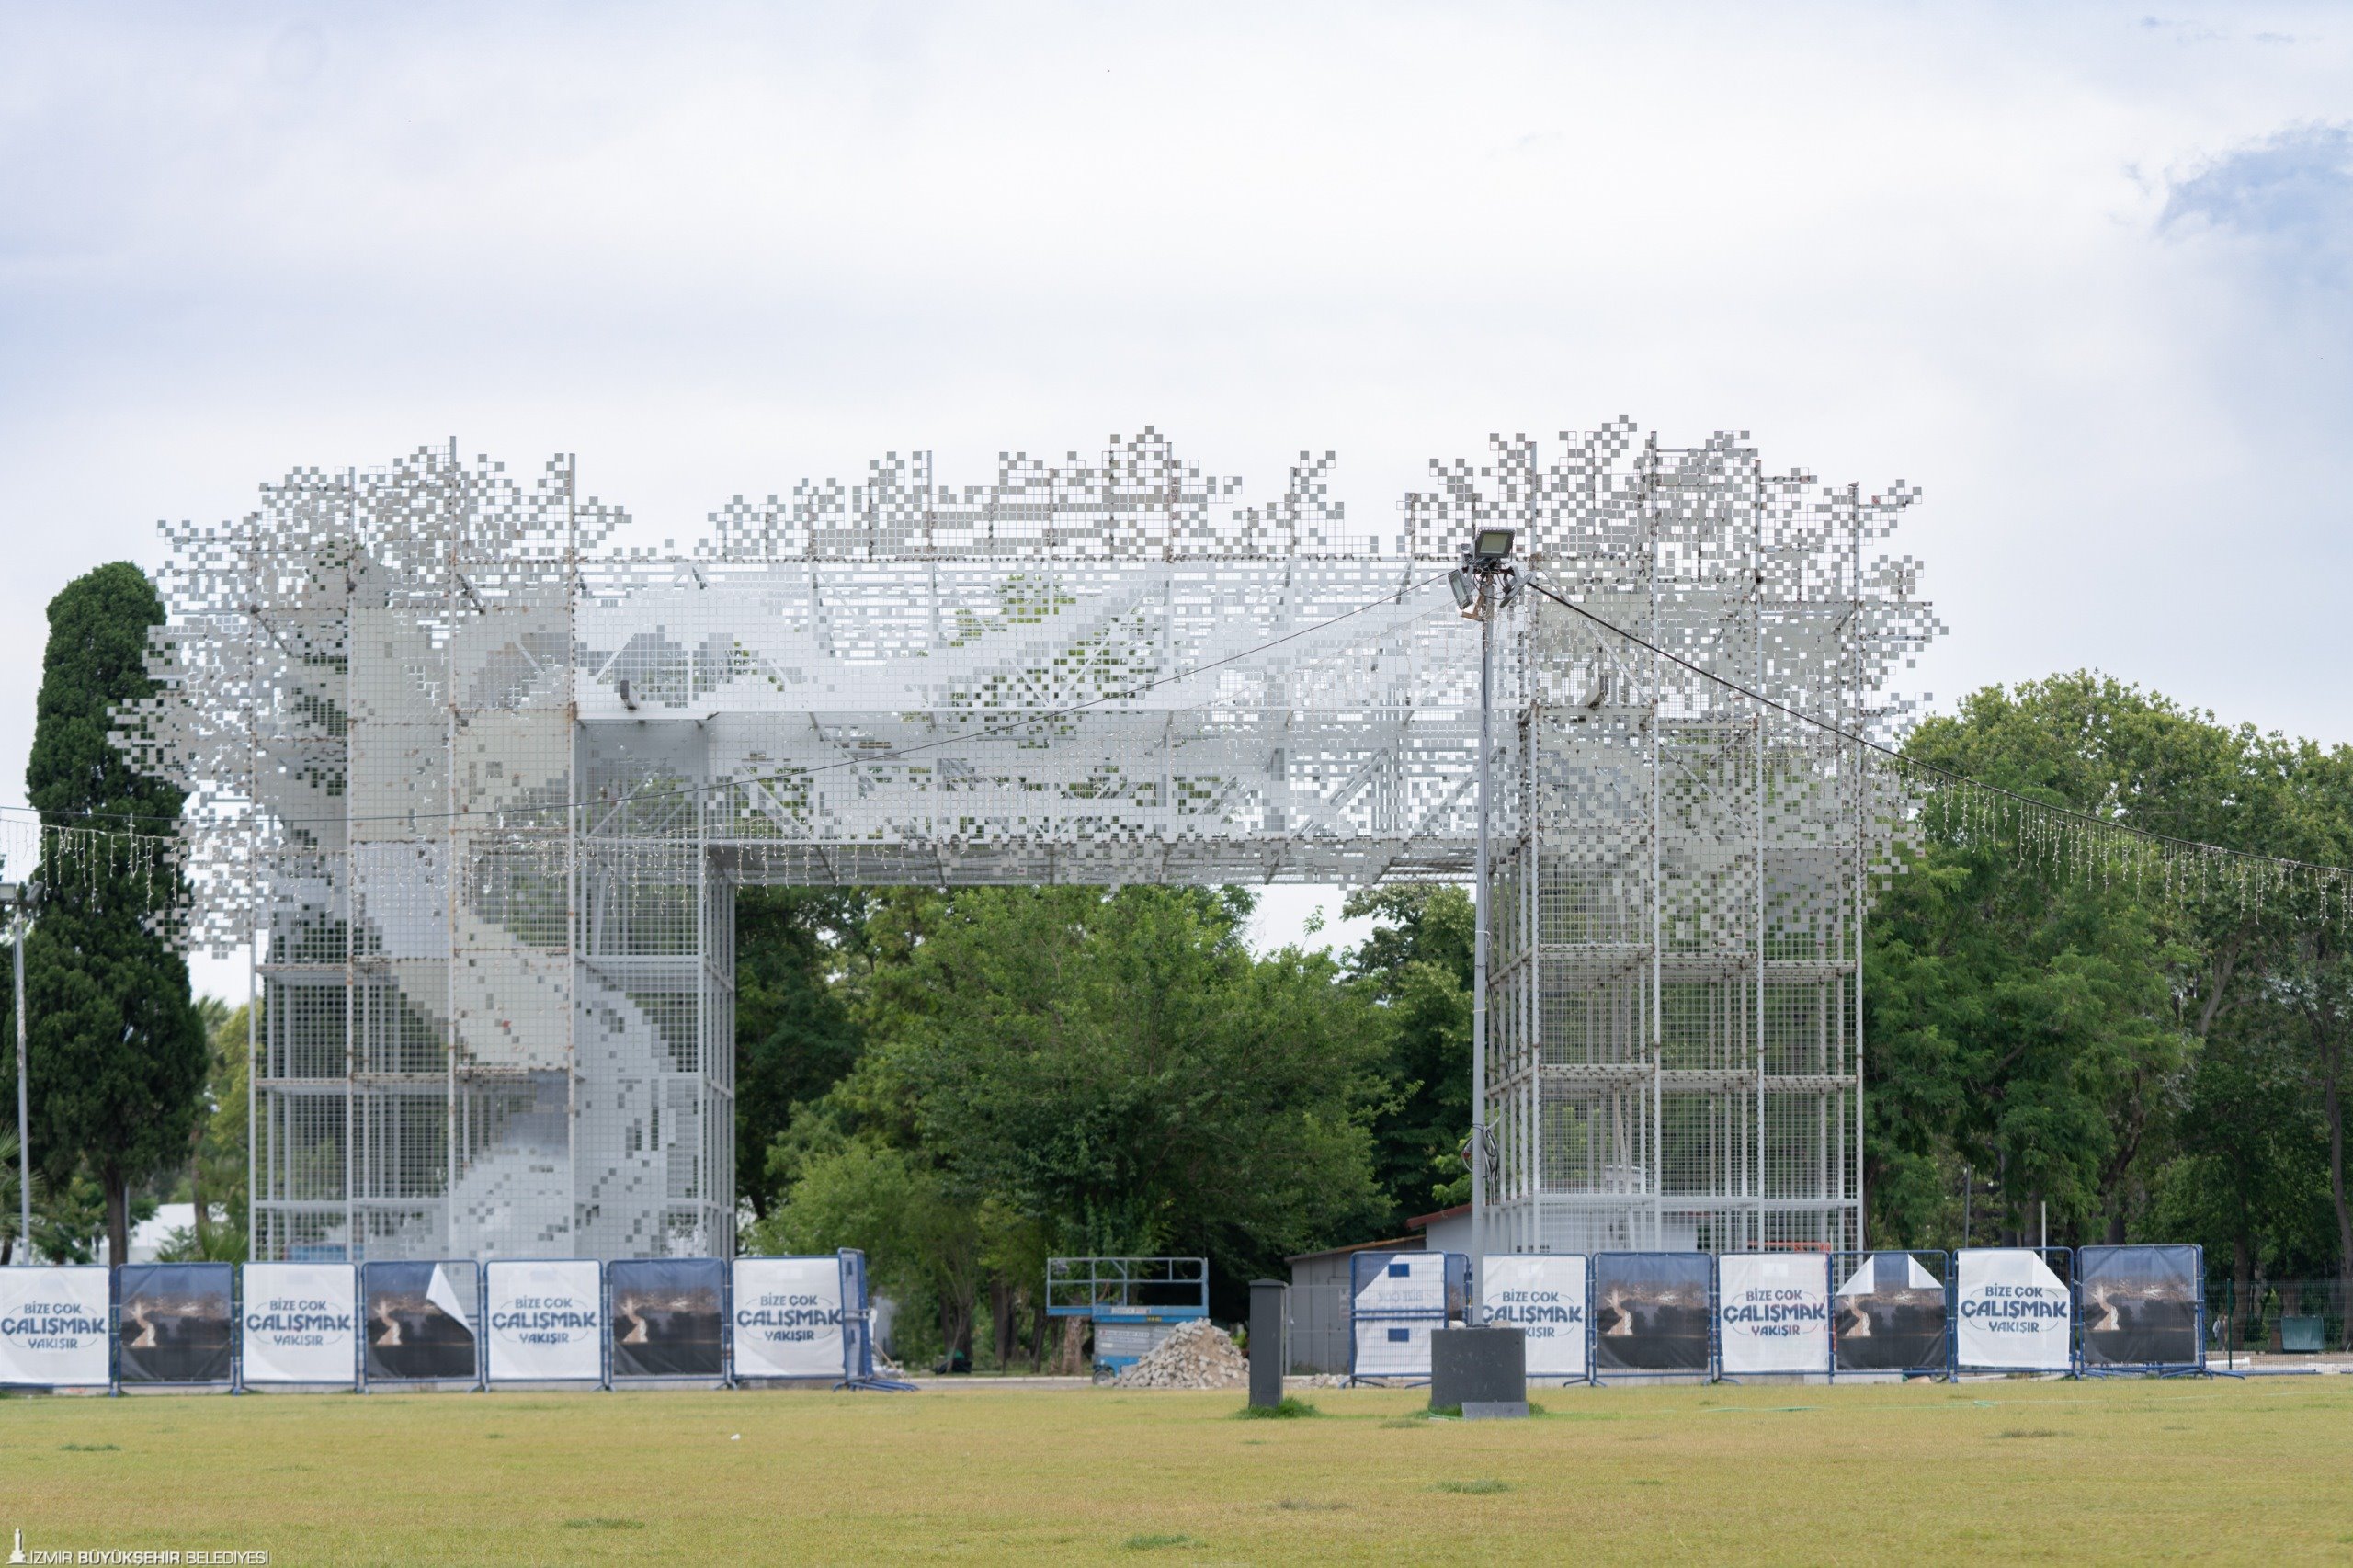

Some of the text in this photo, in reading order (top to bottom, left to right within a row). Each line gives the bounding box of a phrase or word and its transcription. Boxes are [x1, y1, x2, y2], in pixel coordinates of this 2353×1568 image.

[1502, 1289, 1560, 1303] BİZE ÇOK
[1746, 1288, 1803, 1301] BİZE ÇOK
[1985, 1282, 2043, 1298] BİZE ÇOK
[269, 1297, 327, 1312] BİZE ÇOK
[515, 1295, 573, 1309] BİZE ÇOK
[760, 1292, 818, 1306] BİZE ÇOK
[24, 1301, 82, 1314] BİZE ÇOK
[1723, 1303, 1826, 1324] ÇALIŞMAK
[1961, 1300, 2068, 1318] ÇALIŞMAK
[246, 1313, 351, 1332] ÇALIŞMAK
[492, 1312, 597, 1330] ÇALIŞMAK
[736, 1310, 843, 1327] ÇALIŞMAK
[1, 1317, 106, 1335] ÇALIŞMAK
[1751, 1324, 1801, 1336] YAKIŞIR
[1988, 1321, 2040, 1333] YAKIŞIR
[273, 1335, 324, 1346] YAKIŞIR
[518, 1333, 570, 1345] YAKIŞIR
[765, 1330, 815, 1342] YAKIŞIR
[28, 1338, 79, 1349] YAKIŞIR
